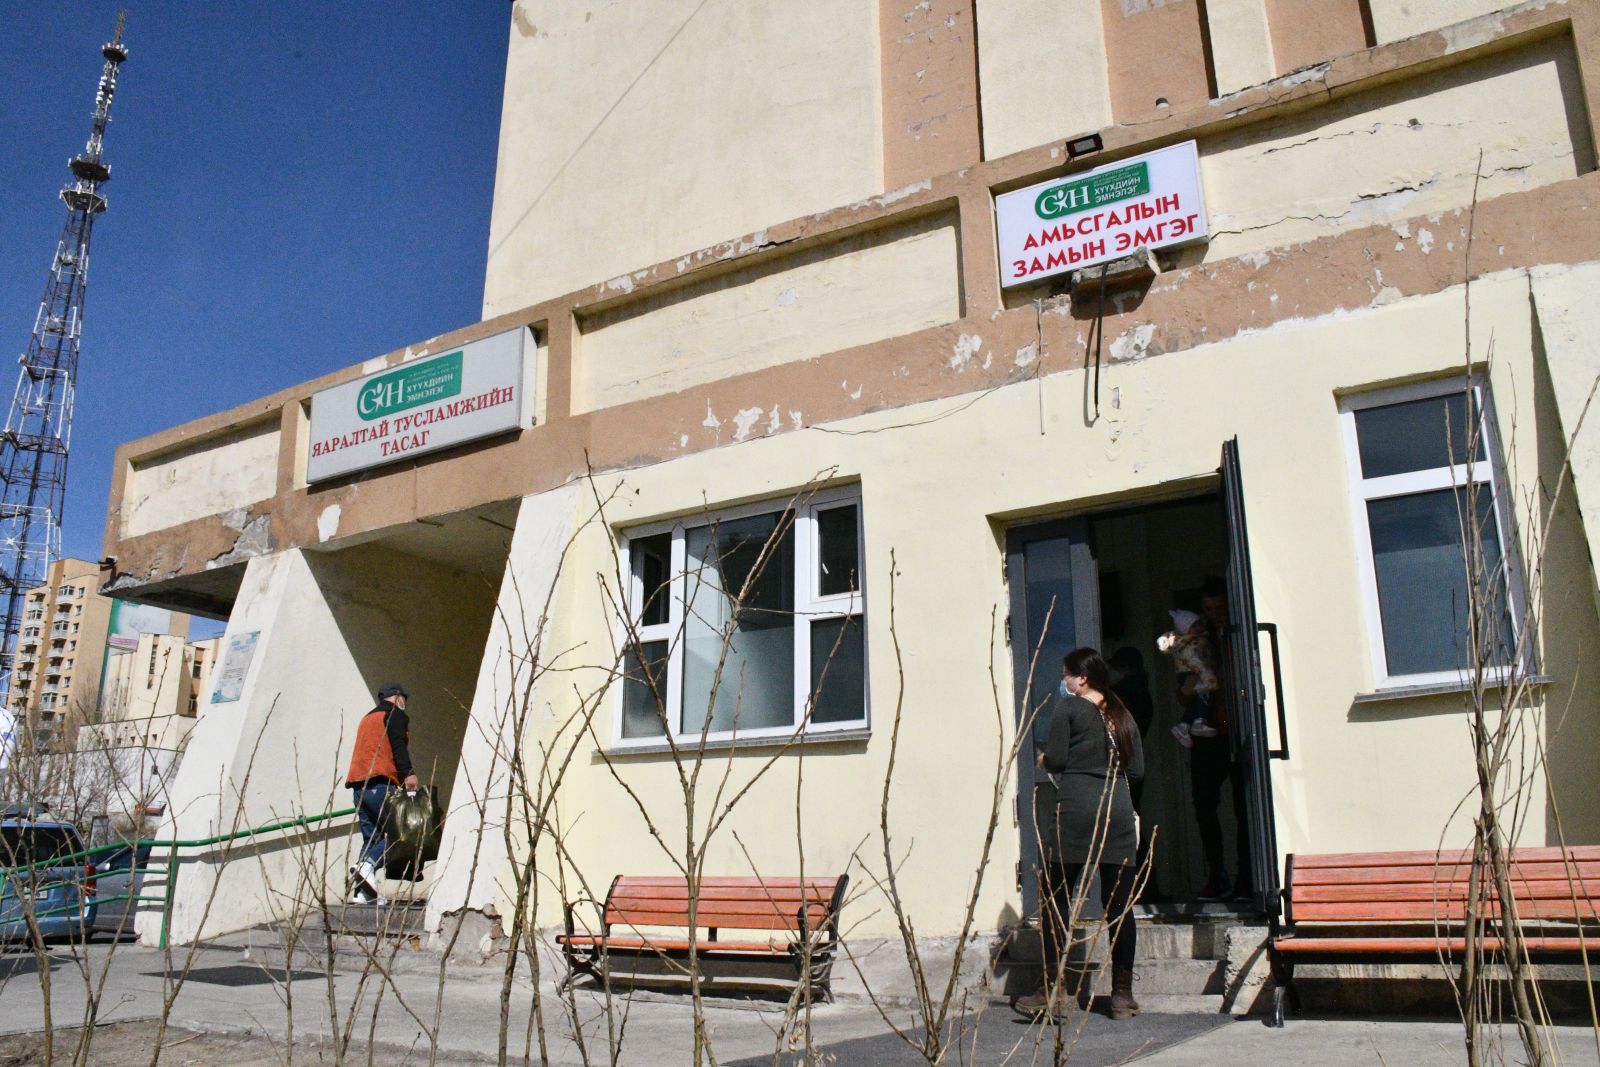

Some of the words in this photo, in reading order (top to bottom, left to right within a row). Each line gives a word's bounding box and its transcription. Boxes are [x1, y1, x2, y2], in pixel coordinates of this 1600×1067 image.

[1023, 193, 1180, 251] АМЬСГАЛЫН
[1095, 185, 1138, 203] ЭМНЭЛЭГ
[1012, 239, 1106, 278] ЗАМЫН
[1114, 214, 1199, 252] ЭМГЭГ
[311, 420, 390, 458] ЯАРАЛТАЙ
[393, 386, 514, 434] ТУСЛАМЖИЙН
[380, 431, 430, 457] ТАСАГ
